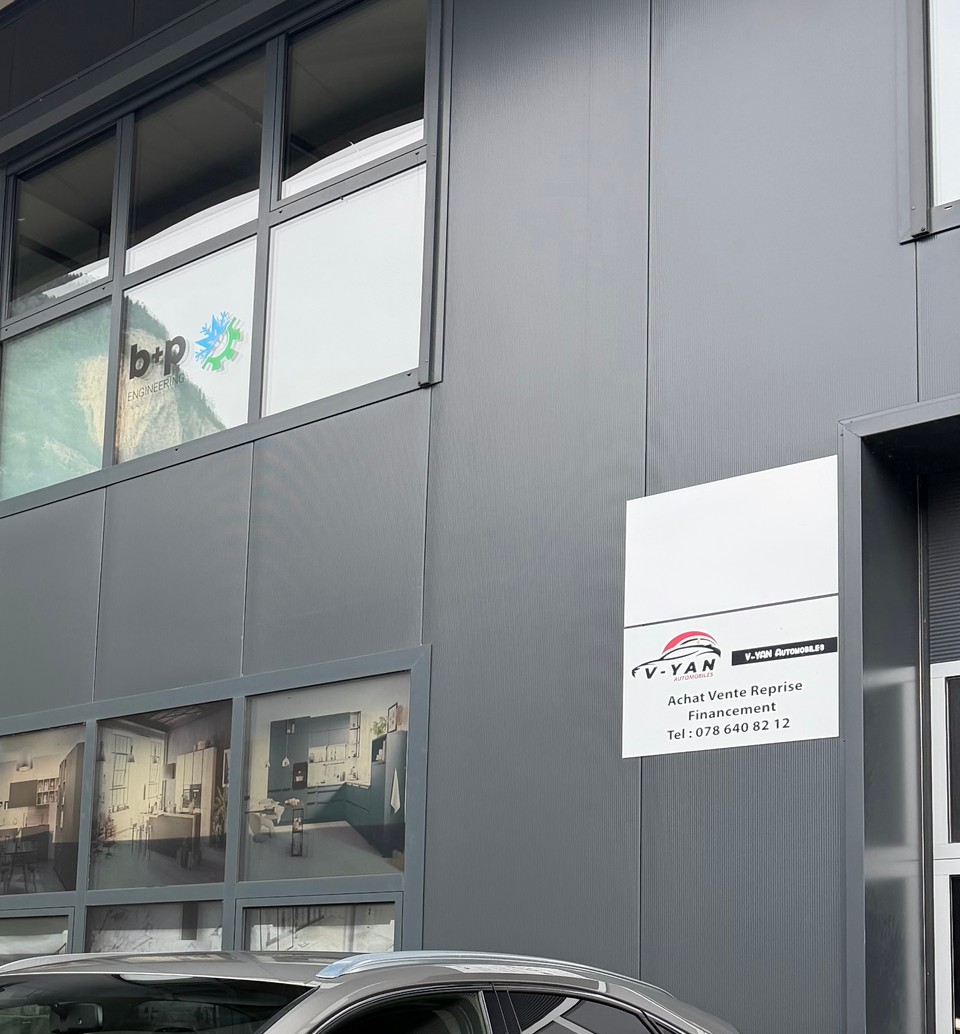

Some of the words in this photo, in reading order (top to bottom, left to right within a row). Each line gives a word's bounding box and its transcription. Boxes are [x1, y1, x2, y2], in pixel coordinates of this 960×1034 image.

[129, 335, 186, 379] b+p
[127, 373, 185, 401] ENGINEERING
[745, 649, 772, 661] V-YAN
[645, 658, 715, 679] V-YAN
[673, 672, 714, 682] AUTOMOBILES
[667, 693, 705, 706] Achat
[708, 689, 747, 701] Vente
[751, 681, 803, 697] Reprise
[688, 702, 777, 721] Financement
[667, 728, 685, 740] Tel
[695, 725, 720, 738] 078
[724, 722, 749, 735] 640
[753, 719, 769, 731] 82
[774, 717, 790, 729] 12
